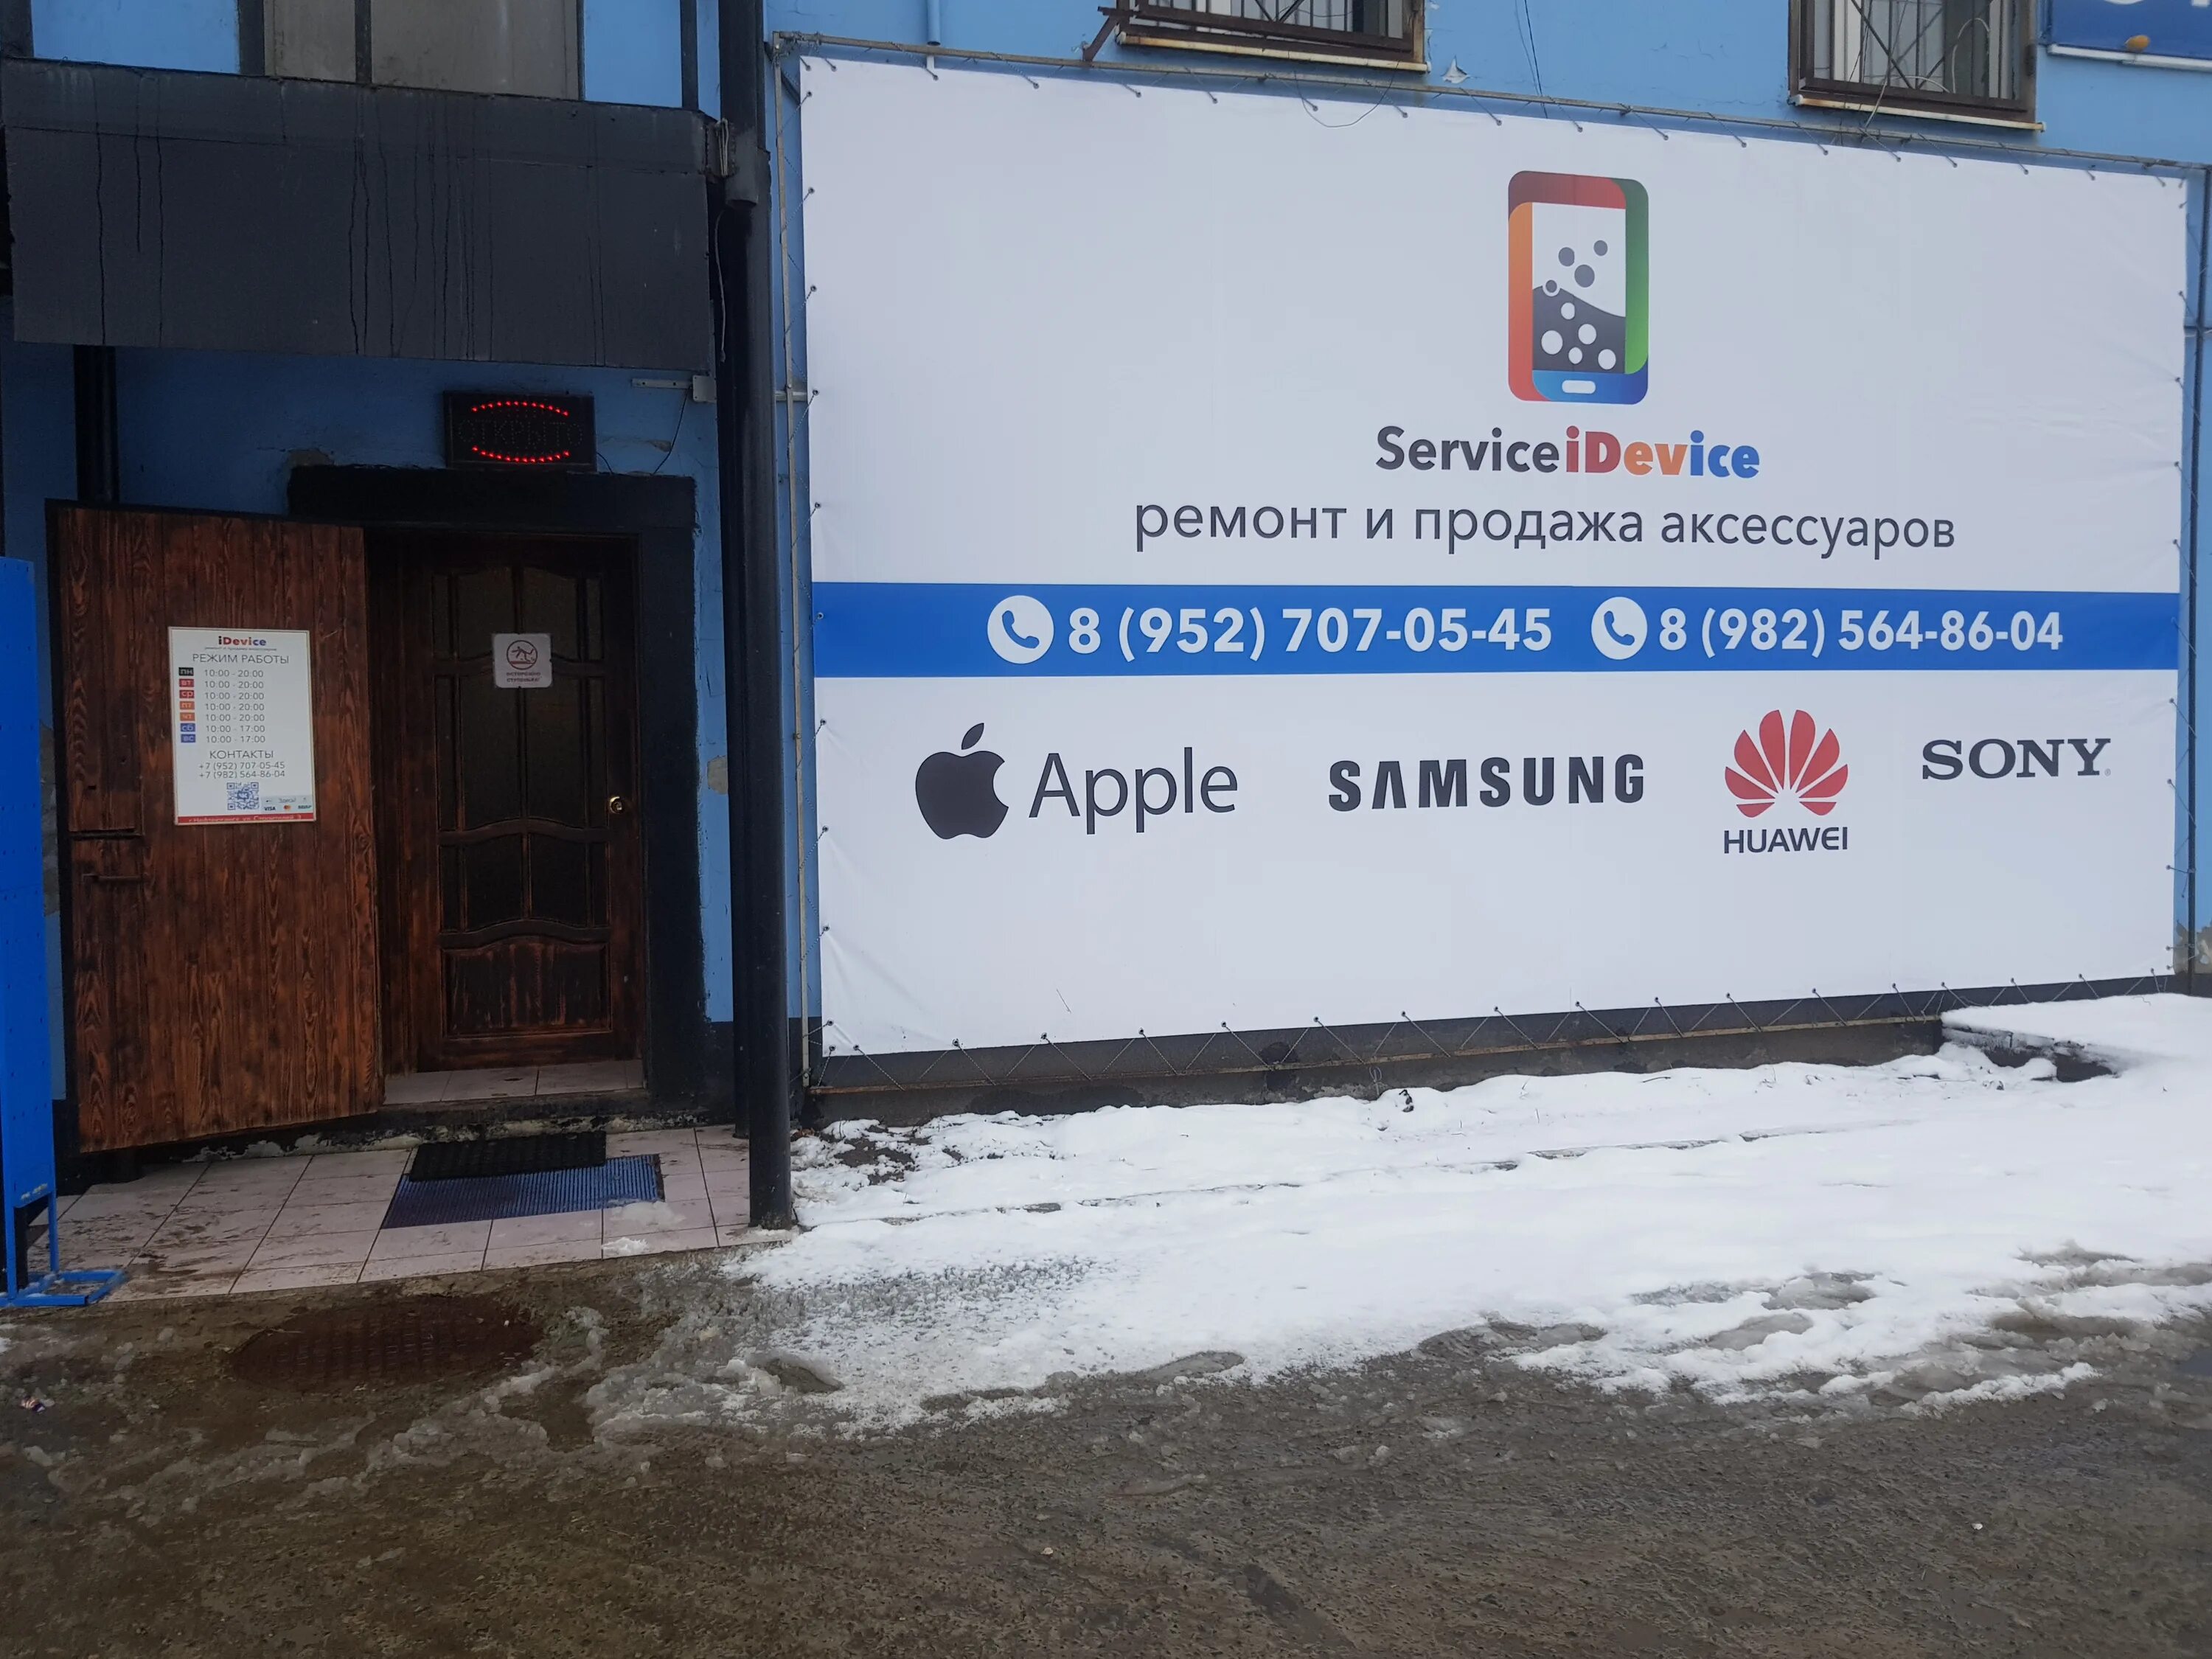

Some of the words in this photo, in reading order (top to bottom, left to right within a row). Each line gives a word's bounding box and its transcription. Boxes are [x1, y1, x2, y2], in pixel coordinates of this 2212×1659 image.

[458, 418, 583, 447] ОТКРЫТО
[1376, 425, 1760, 479] ServiceiDevice
[1137, 504, 1347, 553] ремонт
[1366, 508, 1393, 540] и
[1415, 509, 1643, 555] продажа
[1661, 512, 1955, 560] аксессуаров
[218, 636, 266, 646] iDevice
[1068, 607, 1101, 654] 8
[1119, 607, 1265, 662] (952)
[1282, 607, 1551, 653] 707-05-45
[1659, 608, 1687, 650] 8
[1702, 608, 1825, 658] (982)
[1838, 610, 2063, 651] 564-86-04
[192, 653, 237, 663] РЕЖИМ
[242, 654, 289, 664] РАБОТЫ
[237, 669, 263, 678] 20:00
[205, 692, 230, 700] 10:00
[209, 750, 274, 759] КОНТАКТЫ
[213, 762, 237, 771] (952)
[240, 761, 285, 769] 707-05-45
[1922, 737, 2112, 781] SONY
[213, 771, 237, 779] (982)
[240, 770, 285, 778] 564-86-04
[1328, 754, 1644, 812] SAMSUNG
[1028, 746, 1238, 835] Apple
[1724, 826, 1848, 855] HUAWEI
